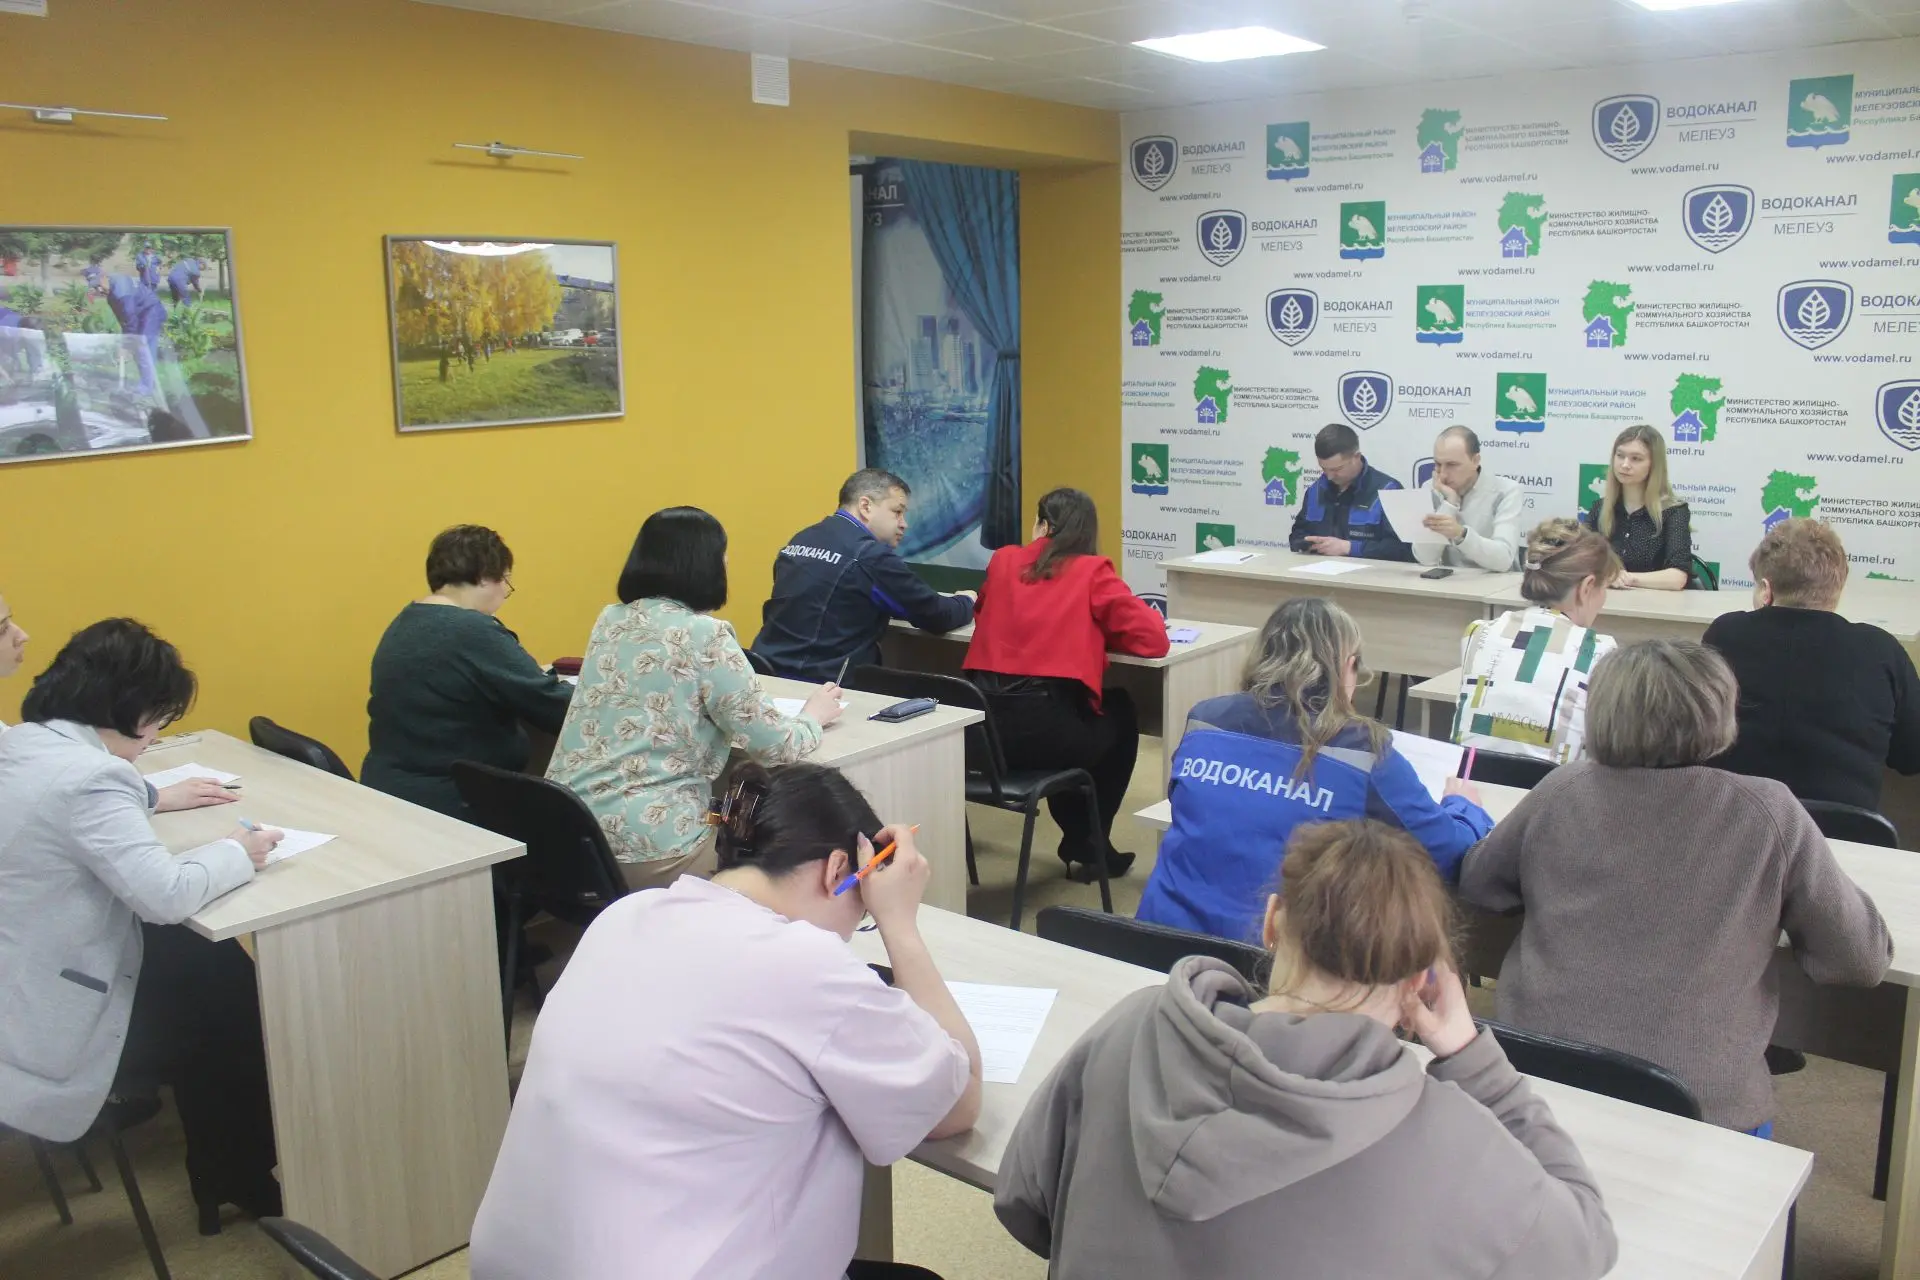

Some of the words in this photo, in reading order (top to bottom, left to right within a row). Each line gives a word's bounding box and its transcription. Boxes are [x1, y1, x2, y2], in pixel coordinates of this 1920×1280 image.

[1666, 100, 1757, 119] ВОДОКАНАЛ
[1678, 129, 1736, 143] МЕЛЕУЗ
[1182, 141, 1245, 155] ВОДОКАНАЛ
[1192, 165, 1231, 174] МЕЛЕУЗ
[1631, 162, 1719, 175] www.vodamel.ru
[1460, 172, 1538, 184] www.vodamel.ru
[1294, 182, 1363, 193] www.vodamel.ru
[1159, 191, 1221, 202] www.vodamel.ru
[1761, 195, 1858, 210] ВОДОКАНАЛ
[1549, 211, 1606, 219] МИНИСТЕРСТВО
[1252, 219, 1318, 231] ВОДОКАНАЛ
[1549, 219, 1614, 228] КОММУНАЛЬНОГО
[1774, 222, 1834, 235] МЕЛЕУЗ
[1548, 229, 1595, 237] РЕСПУБЛИКА
[1597, 227, 1657, 235] БАШКОРТОСТАН
[1261, 241, 1303, 252] МЕЛЕУЗ
[1627, 262, 1714, 272] www.vodamel.ru
[1819, 257, 1919, 269] www.vodamel.ru
[1294, 269, 1362, 279] www.vodamel.ru
[1458, 266, 1535, 276] www.vodamel.ru
[1159, 274, 1221, 284] www.vodamel.ru
[1324, 301, 1392, 312] ВОДОКАНАЛ
[1333, 323, 1377, 333] МЕЛЕУЗ
[1160, 349, 1221, 357] www.vodamel.ru
[1293, 349, 1361, 358] www.vodamel.ru
[1456, 351, 1533, 360] www.vodamel.ru
[1624, 352, 1710, 362] www.vodamel.ru
[1814, 353, 1912, 364] www.vodamel.ru
[1234, 386, 1279, 394] МИНИСТЕРСТВО
[1398, 386, 1471, 397] ВОДОКАНАЛ
[1620, 389, 1647, 397] РАЙОН
[1272, 402, 1319, 410] БАШКОРТОСТАН
[1727, 398, 1790, 406] МИНИСТЕРСТВО
[1408, 407, 1454, 419] МЕЛЕУЗ
[1727, 407, 1798, 416] КОММУНАЛЬНОГО
[1726, 416, 1777, 425] РЕСПУБЛИКА
[1780, 418, 1847, 427] БАШКОРТОСТАН
[1159, 427, 1221, 437] www.vodamel.ru
[1479, 439, 1530, 449] vodamel.ru
[1807, 452, 1904, 465] www.vodamel.ru
[1708, 485, 1737, 494] РАЙОН
[1698, 497, 1725, 505] РАЙОН
[1821, 497, 1888, 507] МИНИСТЕРСТВО
[1160, 504, 1220, 516] www.vodamel.ru
[1820, 506, 1896, 517] КОММУНАЛЬНОГО
[780, 544, 842, 565] ВОДОКАНАЛ
[1128, 549, 1163, 560] МЕЛЕУЗ
[1178, 757, 1335, 813] ВОДОКАНАЛ
